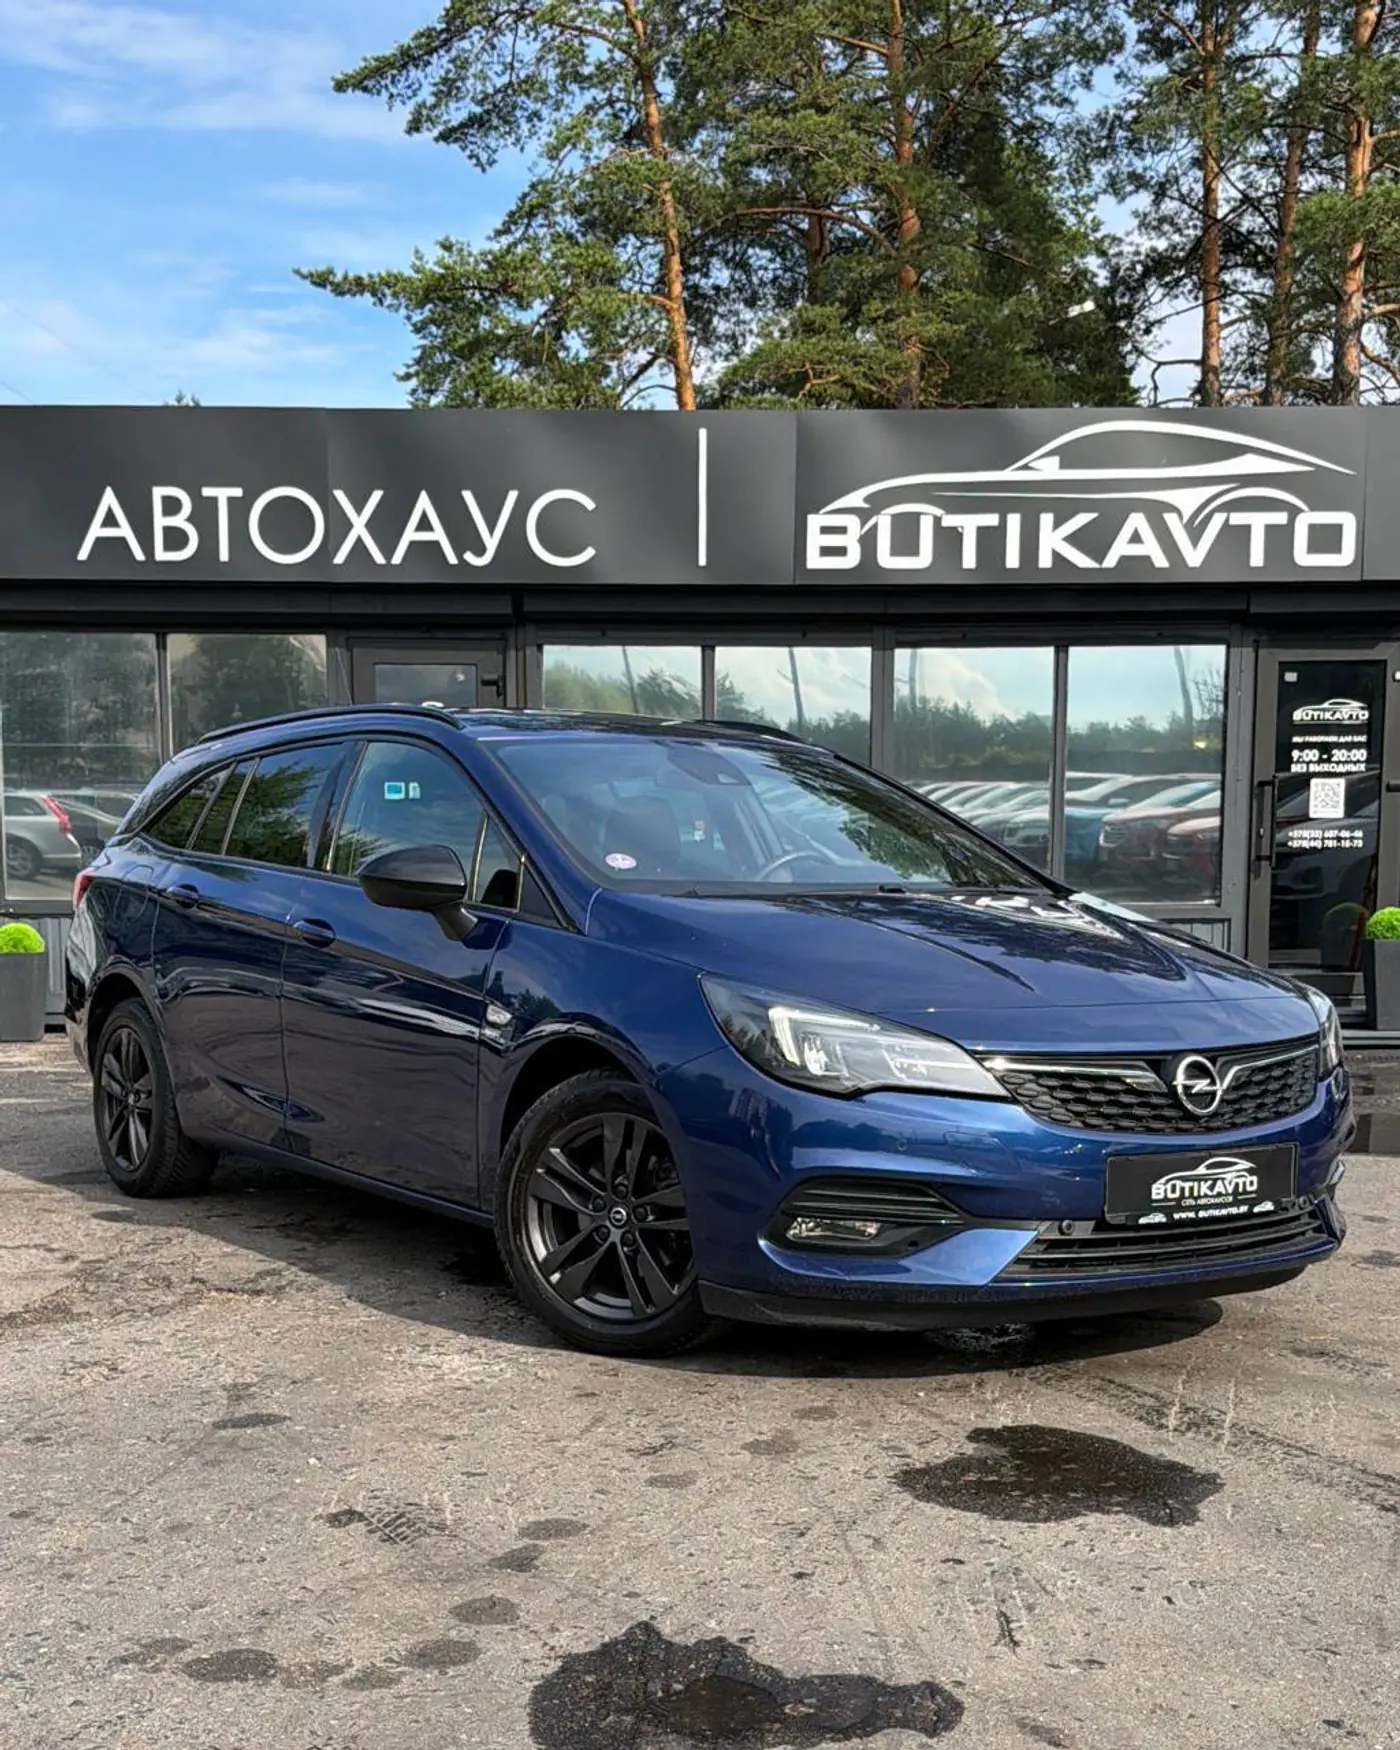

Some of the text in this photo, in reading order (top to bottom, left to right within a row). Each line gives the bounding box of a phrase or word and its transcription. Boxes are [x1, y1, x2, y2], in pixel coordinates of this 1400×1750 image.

[77, 485, 597, 567] АВТОХАУС
[805, 510, 1357, 570] BUTIKAVTO
[1292, 709, 1369, 721] BUTIKAVTO
[1291, 749, 1319, 762] 9:00
[1331, 749, 1367, 762] 20:00
[1291, 762, 1366, 773] БЕЗ ВЫХОДНЫХ
[1151, 1175, 1258, 1200] BUTIKAVTO
